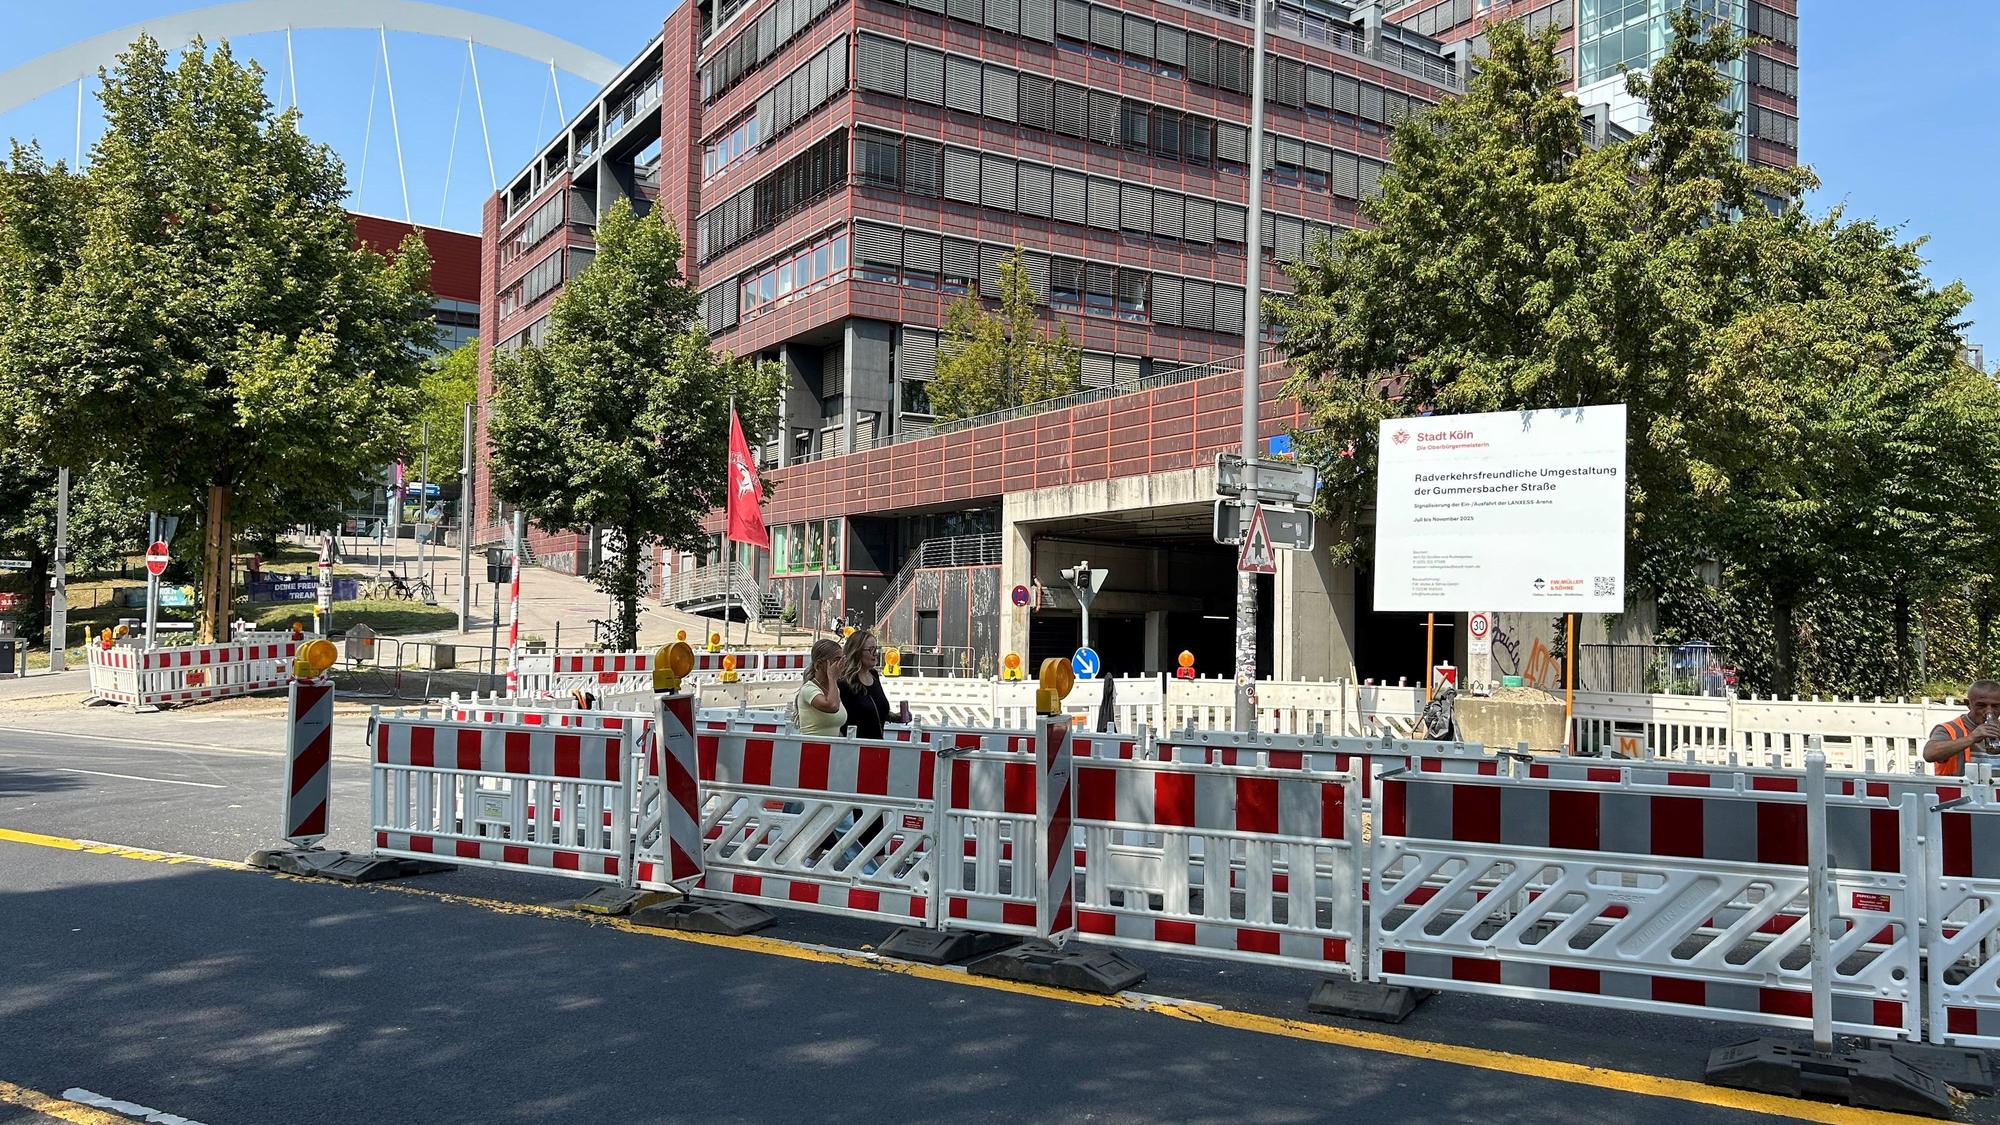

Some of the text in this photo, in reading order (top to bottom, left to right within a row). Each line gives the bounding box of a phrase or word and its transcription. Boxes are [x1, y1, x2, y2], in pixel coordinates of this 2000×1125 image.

[1417, 429, 1474, 442] Stadt Köln
[1427, 442, 1490, 451] Oberbürgermeisterin
[1414, 466, 1617, 482] Radverkehrsfreundliche Umgestaltung
[1414, 482, 1557, 496] der Gummersbacher Straße
[274, 582, 297, 591] DEINE
[1473, 620, 1485, 631] 30
